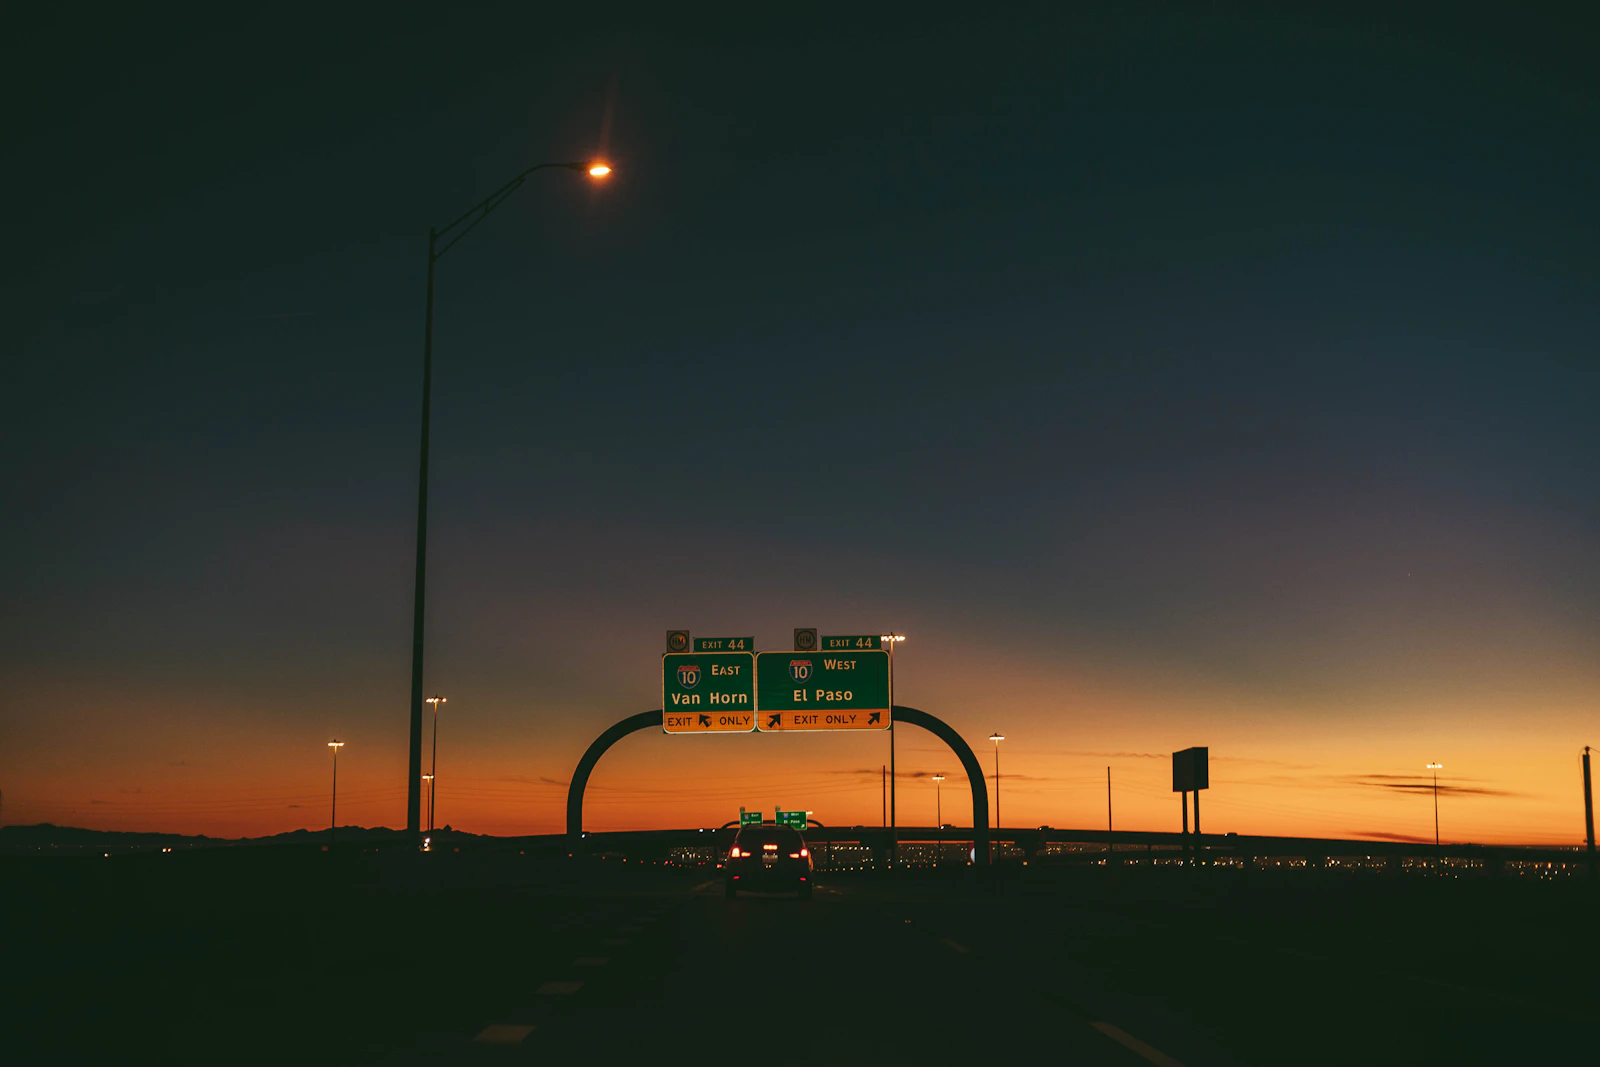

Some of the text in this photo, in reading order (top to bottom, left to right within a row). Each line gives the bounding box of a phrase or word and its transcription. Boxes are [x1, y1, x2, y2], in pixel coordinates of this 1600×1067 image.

[702, 639, 744, 650] EXIT 44
[800, 635, 812, 644] HM
[829, 637, 873, 648] EXIT 44
[711, 664, 741, 676] EAST
[823, 659, 857, 670] WEST
[682, 671, 697, 684] 10
[793, 666, 808, 679] 10
[671, 692, 748, 704] Van Horn
[793, 689, 853, 702] El Paso
[667, 716, 751, 727] EXIT ONLY
[794, 714, 857, 724] EXIT ONLY
